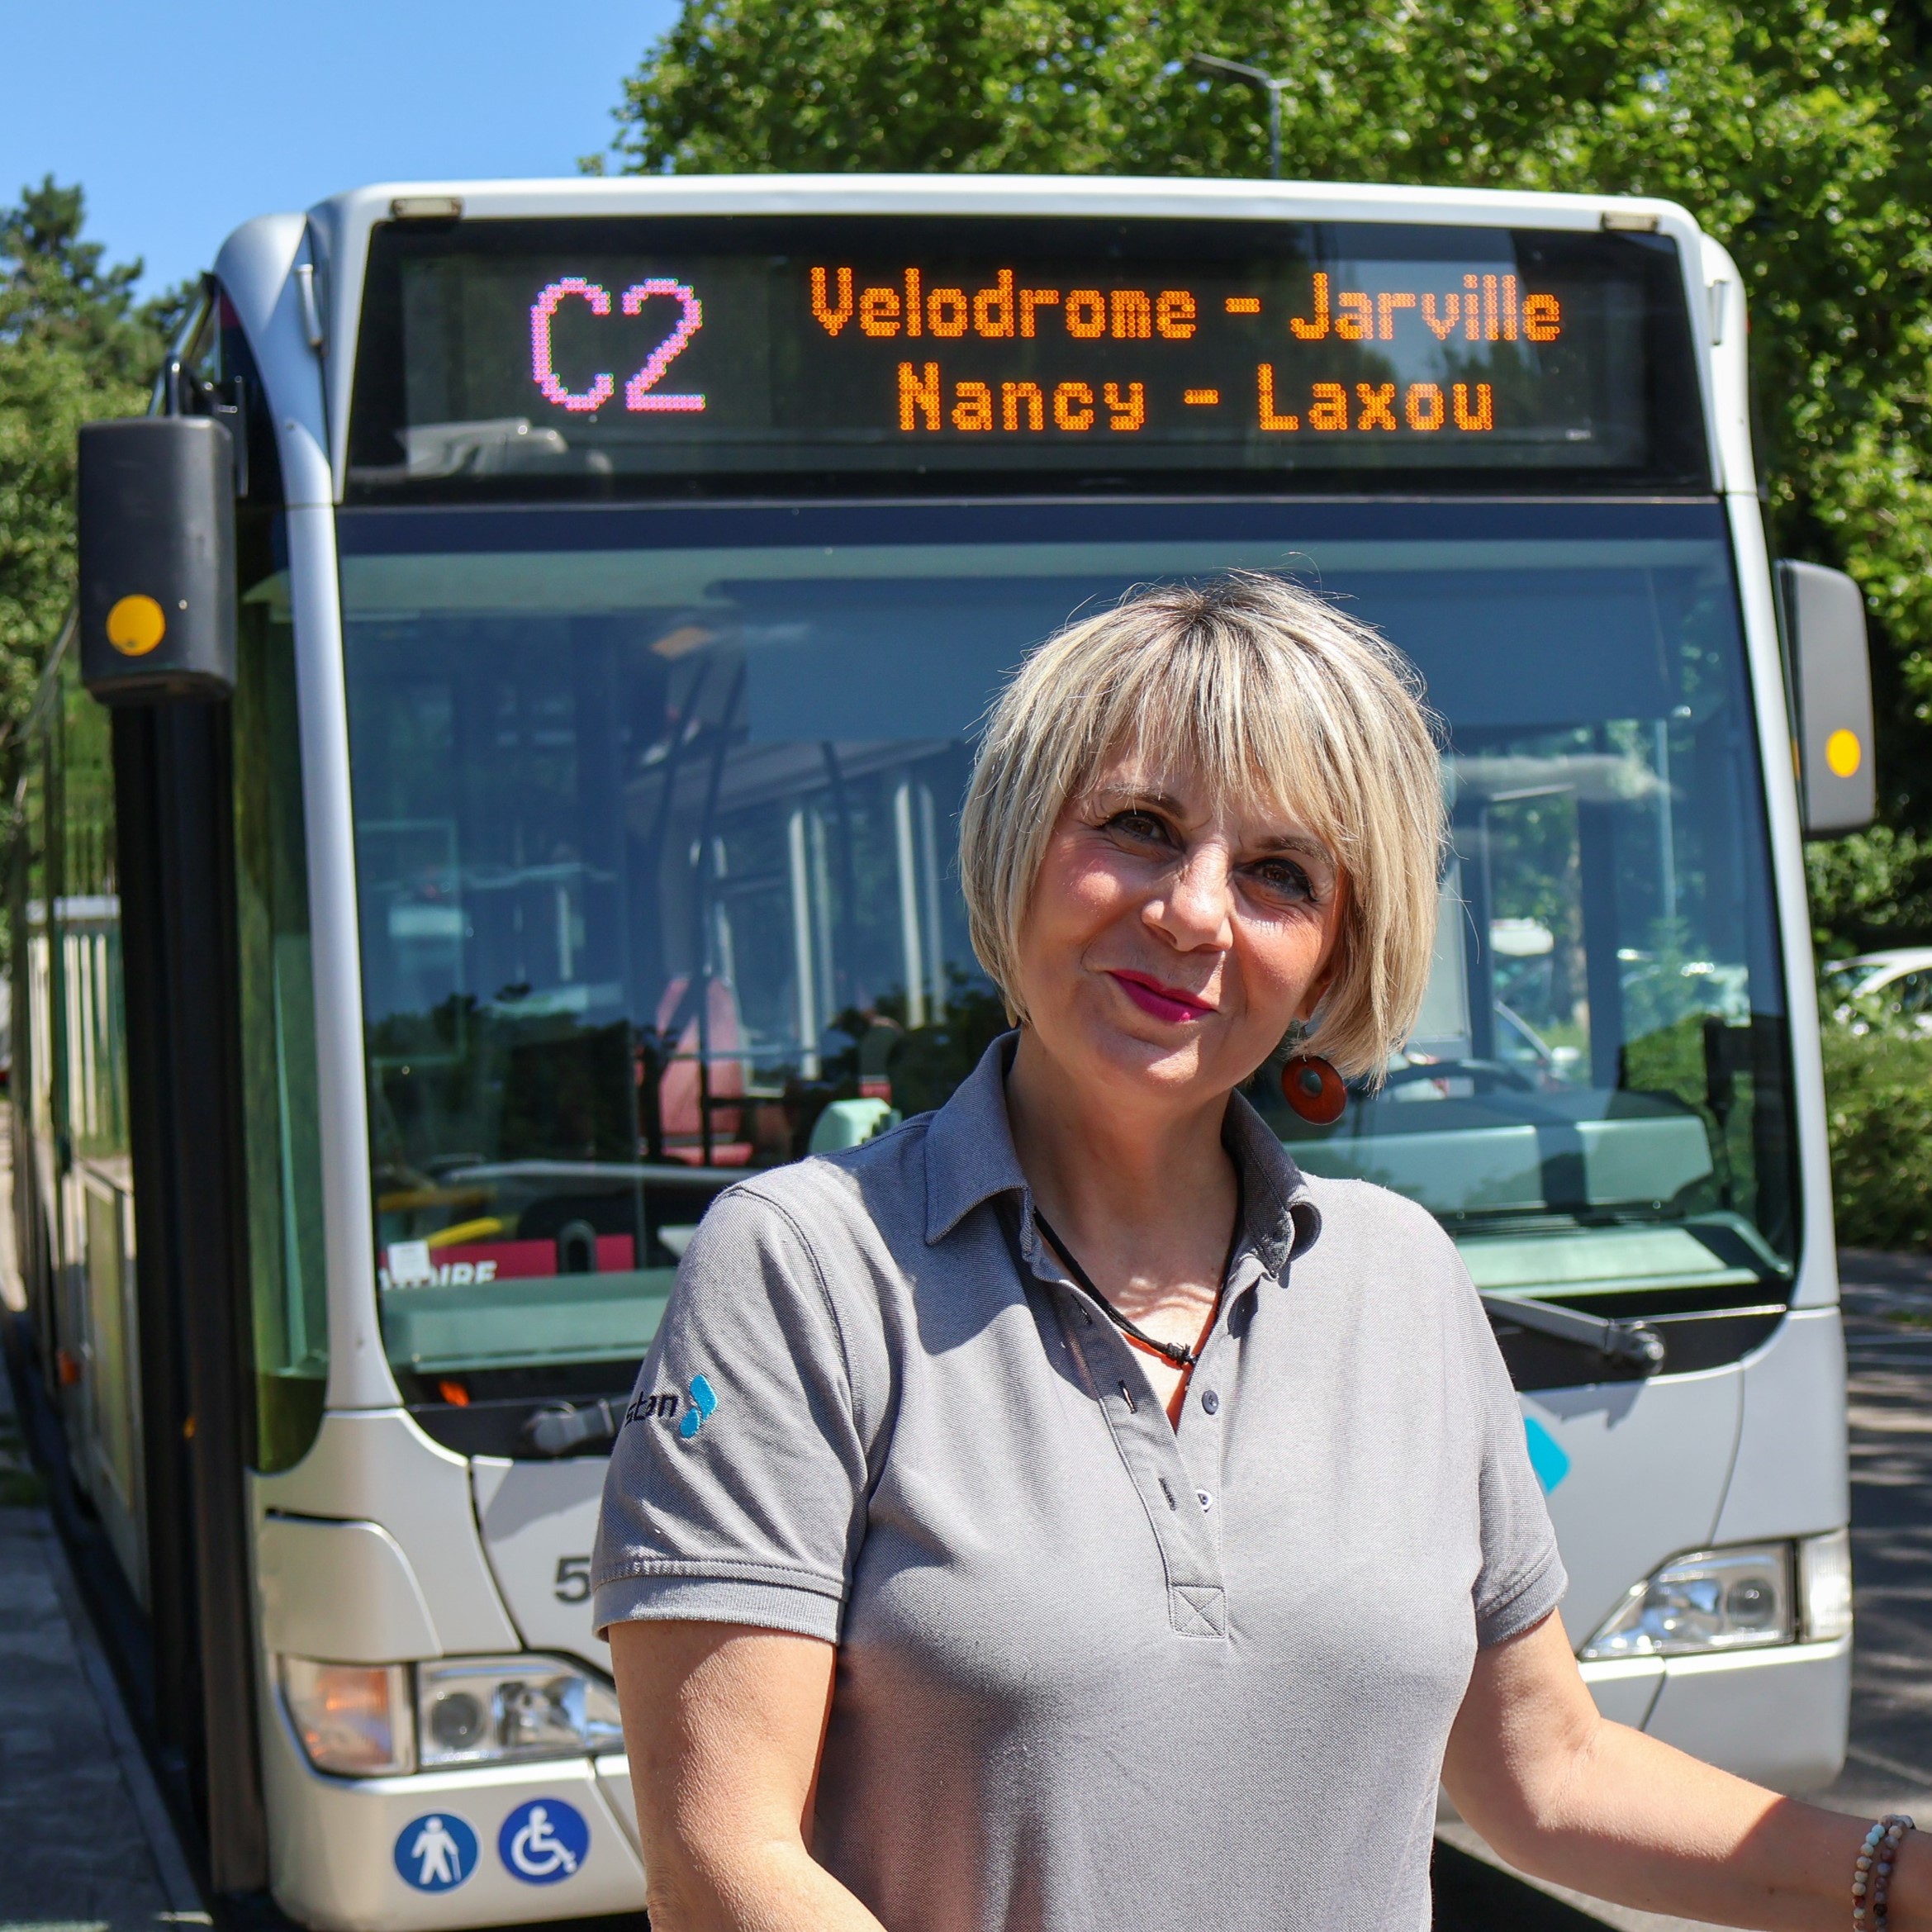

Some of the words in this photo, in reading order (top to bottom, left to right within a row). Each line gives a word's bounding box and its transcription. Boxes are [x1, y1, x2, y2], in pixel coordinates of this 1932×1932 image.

[810, 266, 1197, 339] Velodrome
[1290, 272, 1561, 341] Jarville
[530, 276, 705, 411] C2
[898, 361, 1146, 430] Nancy
[1257, 363, 1493, 430] Laxou
